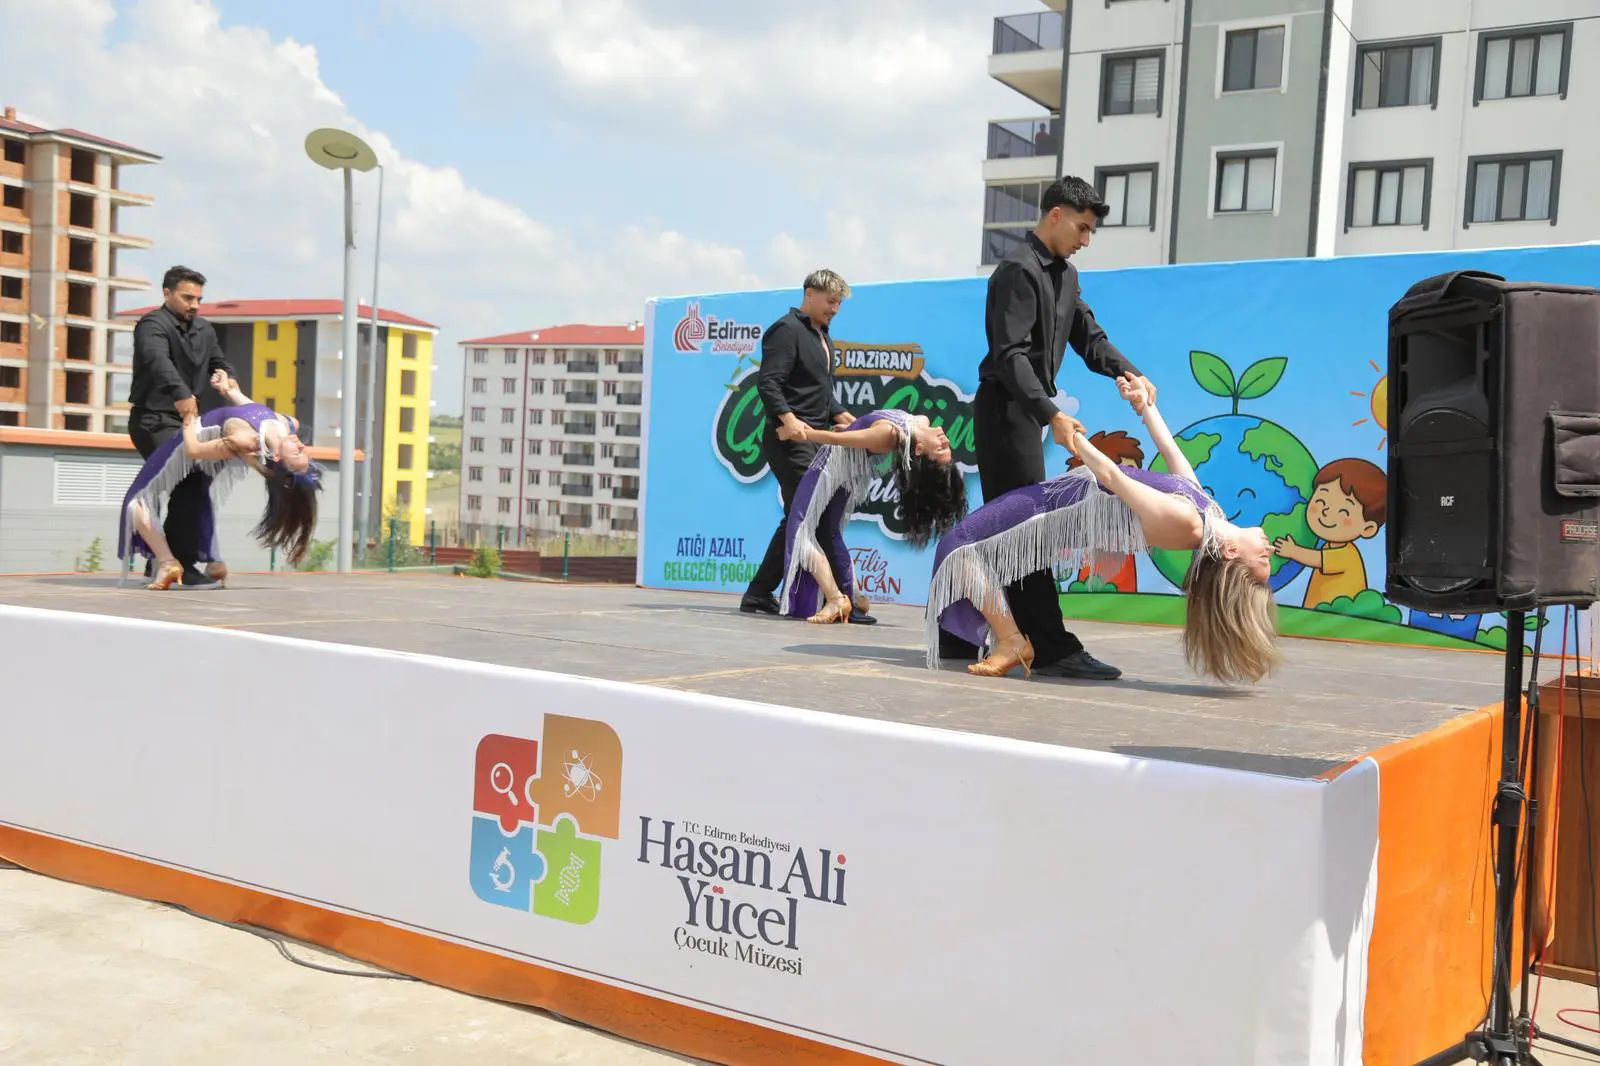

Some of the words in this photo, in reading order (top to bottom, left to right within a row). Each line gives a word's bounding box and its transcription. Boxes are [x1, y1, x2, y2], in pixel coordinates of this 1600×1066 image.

[708, 321, 761, 340] Edirne
[832, 381, 876, 405] NYA
[1440, 495, 1454, 506] RCF
[676, 533, 706, 557] ATIĞI
[708, 537, 747, 560] AZALT,
[663, 559, 718, 582] GELECEĞİ
[848, 548, 888, 584] Filiz
[856, 575, 902, 595] NCAN
[682, 820, 702, 836] T.C.
[704, 825, 737, 842] Edirne
[739, 832, 792, 853] Belediyesi
[637, 816, 774, 890] Hasan
[777, 847, 847, 906] Ali
[676, 876, 800, 950] Yücel
[673, 927, 729, 958] Çocuk
[734, 940, 803, 976] Müzesi
